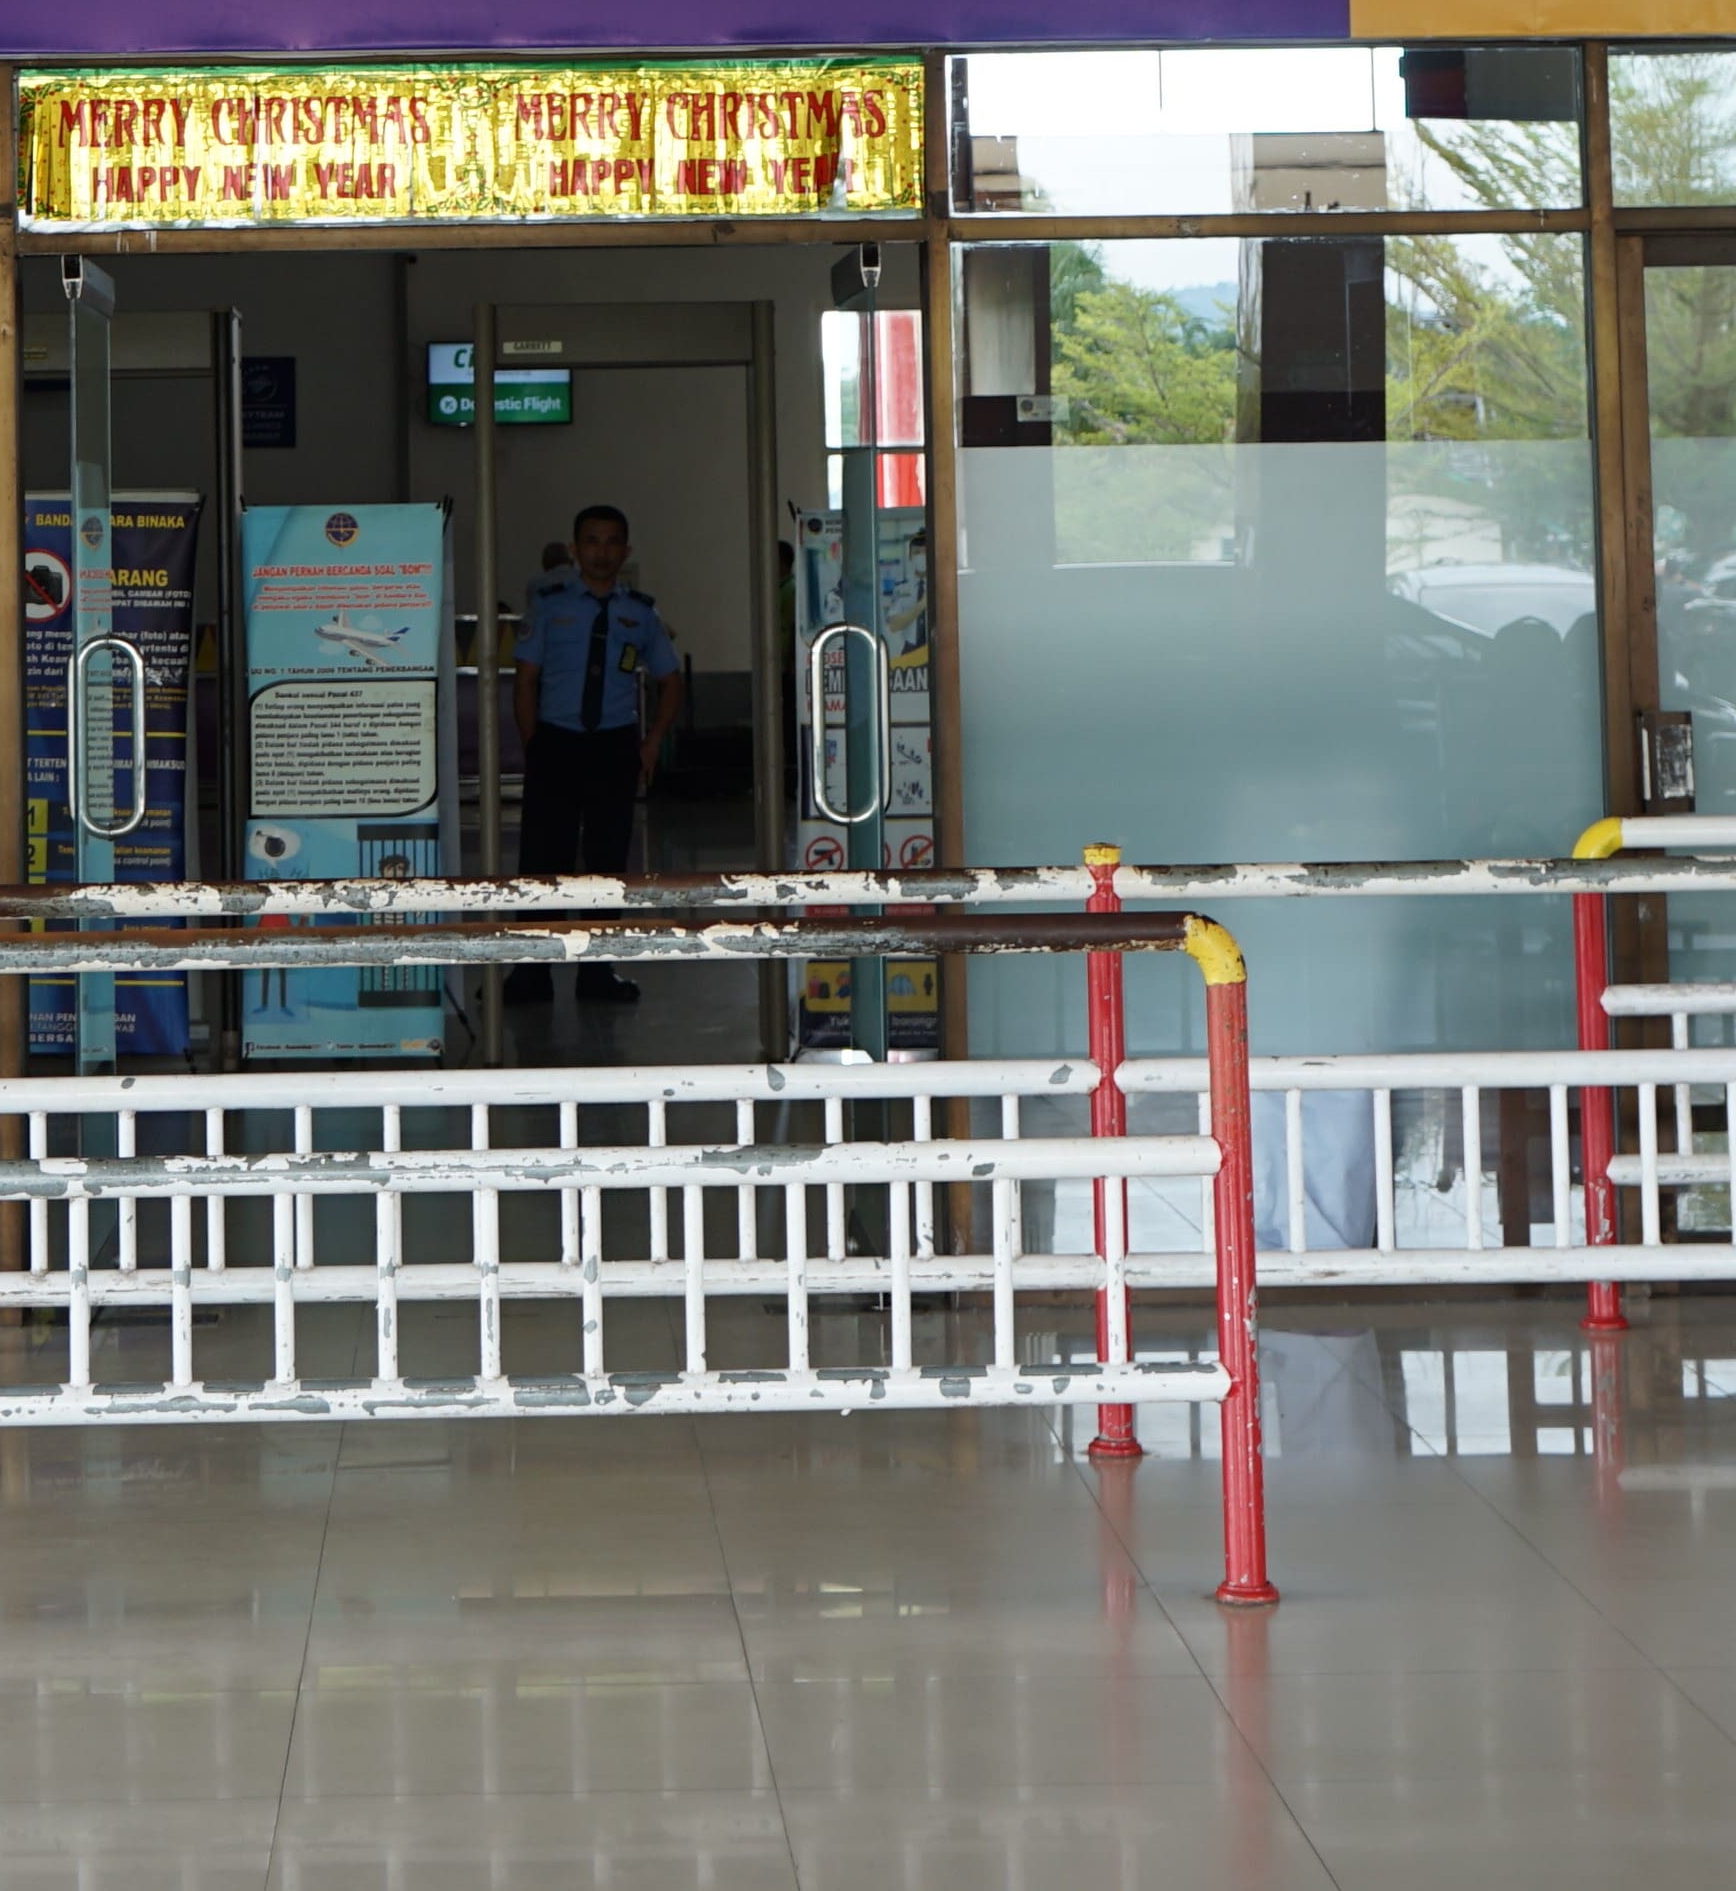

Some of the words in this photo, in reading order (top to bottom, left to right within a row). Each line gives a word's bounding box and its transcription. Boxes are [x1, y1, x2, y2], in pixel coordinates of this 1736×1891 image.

[60, 98, 193, 147] MERRY
[212, 96, 430, 148] CHRISTMAS
[516, 92, 643, 142] MERRY
[667, 89, 886, 142] CHRISTMAS
[92, 164, 199, 203] HAPPY
[223, 165, 292, 201] NEW
[316, 163, 396, 199] YEAR
[550, 158, 654, 198] HAPPY
[680, 158, 746, 195] NEW
[524, 396, 561, 413] Flight
[137, 515, 184, 528] BINAKA
